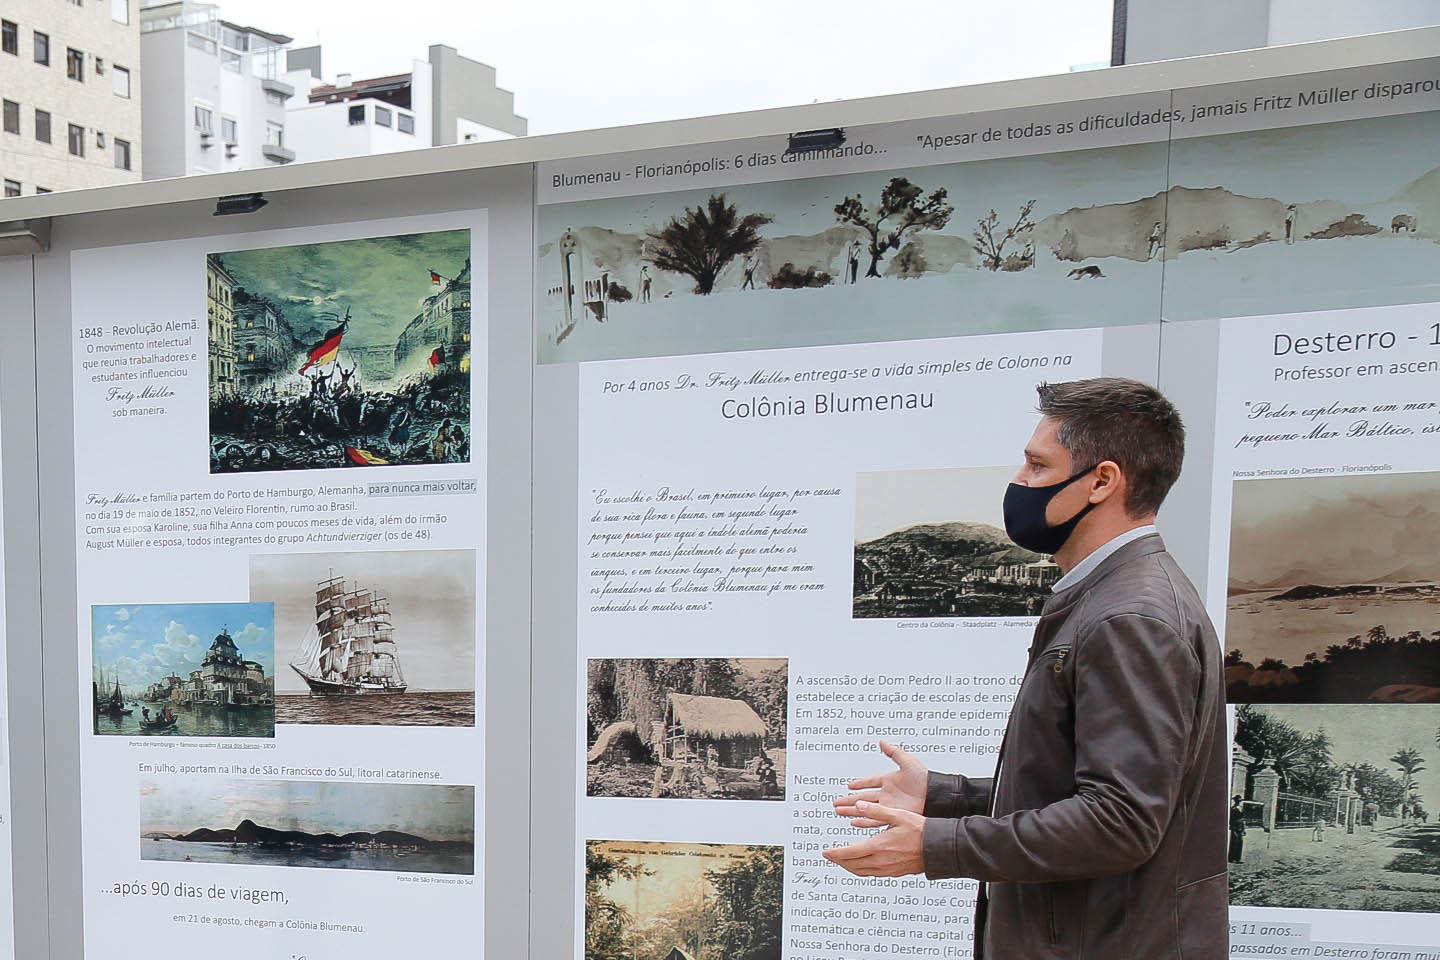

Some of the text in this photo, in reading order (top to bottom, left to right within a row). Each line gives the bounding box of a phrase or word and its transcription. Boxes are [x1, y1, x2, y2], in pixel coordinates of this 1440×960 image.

[552, 171, 621, 189] Blumenau
[635, 157, 730, 179] Florianópolis:
[734, 153, 744, 170] 6
[747, 151, 780, 169] dias
[917, 132, 979, 152] "Apesar
[981, 126, 1002, 144] de
[1006, 122, 1052, 141] todas
[1055, 121, 1074, 137] as
[1078, 102, 1186, 132] dificuldades,
[1189, 99, 1248, 124] jamais
[1253, 94, 1293, 113] Fritz
[1298, 86, 1360, 107] Müller
[79, 318, 200, 340] 1848 Revolução Alemã.
[86, 335, 192, 355] O movimento intelectual
[1274, 331, 1396, 356] Desterro
[82, 352, 197, 372] que reunia trabalhadores e
[1274, 360, 1440, 382] Professor em ascen
[91, 366, 188, 385] estudantes influenciou
[603, 354, 1072, 394] Por 4 anos Dr. Fritz Müller entrega-se a vida simples de Colono na
[105, 384, 174, 406] Fritz Müller
[721, 392, 933, 420] Colônia Blumenau
[112, 405, 168, 419] sob maneira.
[1245, 400, 1437, 422] "Poder explorar um mar
[1234, 419, 1415, 449] pequeno Mar Báltico,
[1232, 462, 1393, 478] Nossa Senhora do Desterro Florianópolis
[85, 478, 477, 509] Fritz Müller e família partem do Porto de Hamburgo, Alemanha, para nunca mais voltar,
[795, 674, 805, 687] A
[806, 674, 858, 687] ascensão
[860, 673, 875, 687] de
[878, 674, 905, 687] Dom
[908, 674, 942, 687] Pedro
[945, 674, 952, 686] II
[955, 676, 970, 687] ao
[973, 675, 1006, 687] trono
[101, 879, 289, 906] ...após 90 dias de viagem,
[172, 913, 366, 934] em 21 de agosto, chegam a Colônia Blumenau.
[1239, 922, 1302, 938] 11 anos...
[1230, 942, 1288, 959] passados
[1290, 946, 1311, 957] em
[1313, 944, 1369, 960] Desterro
